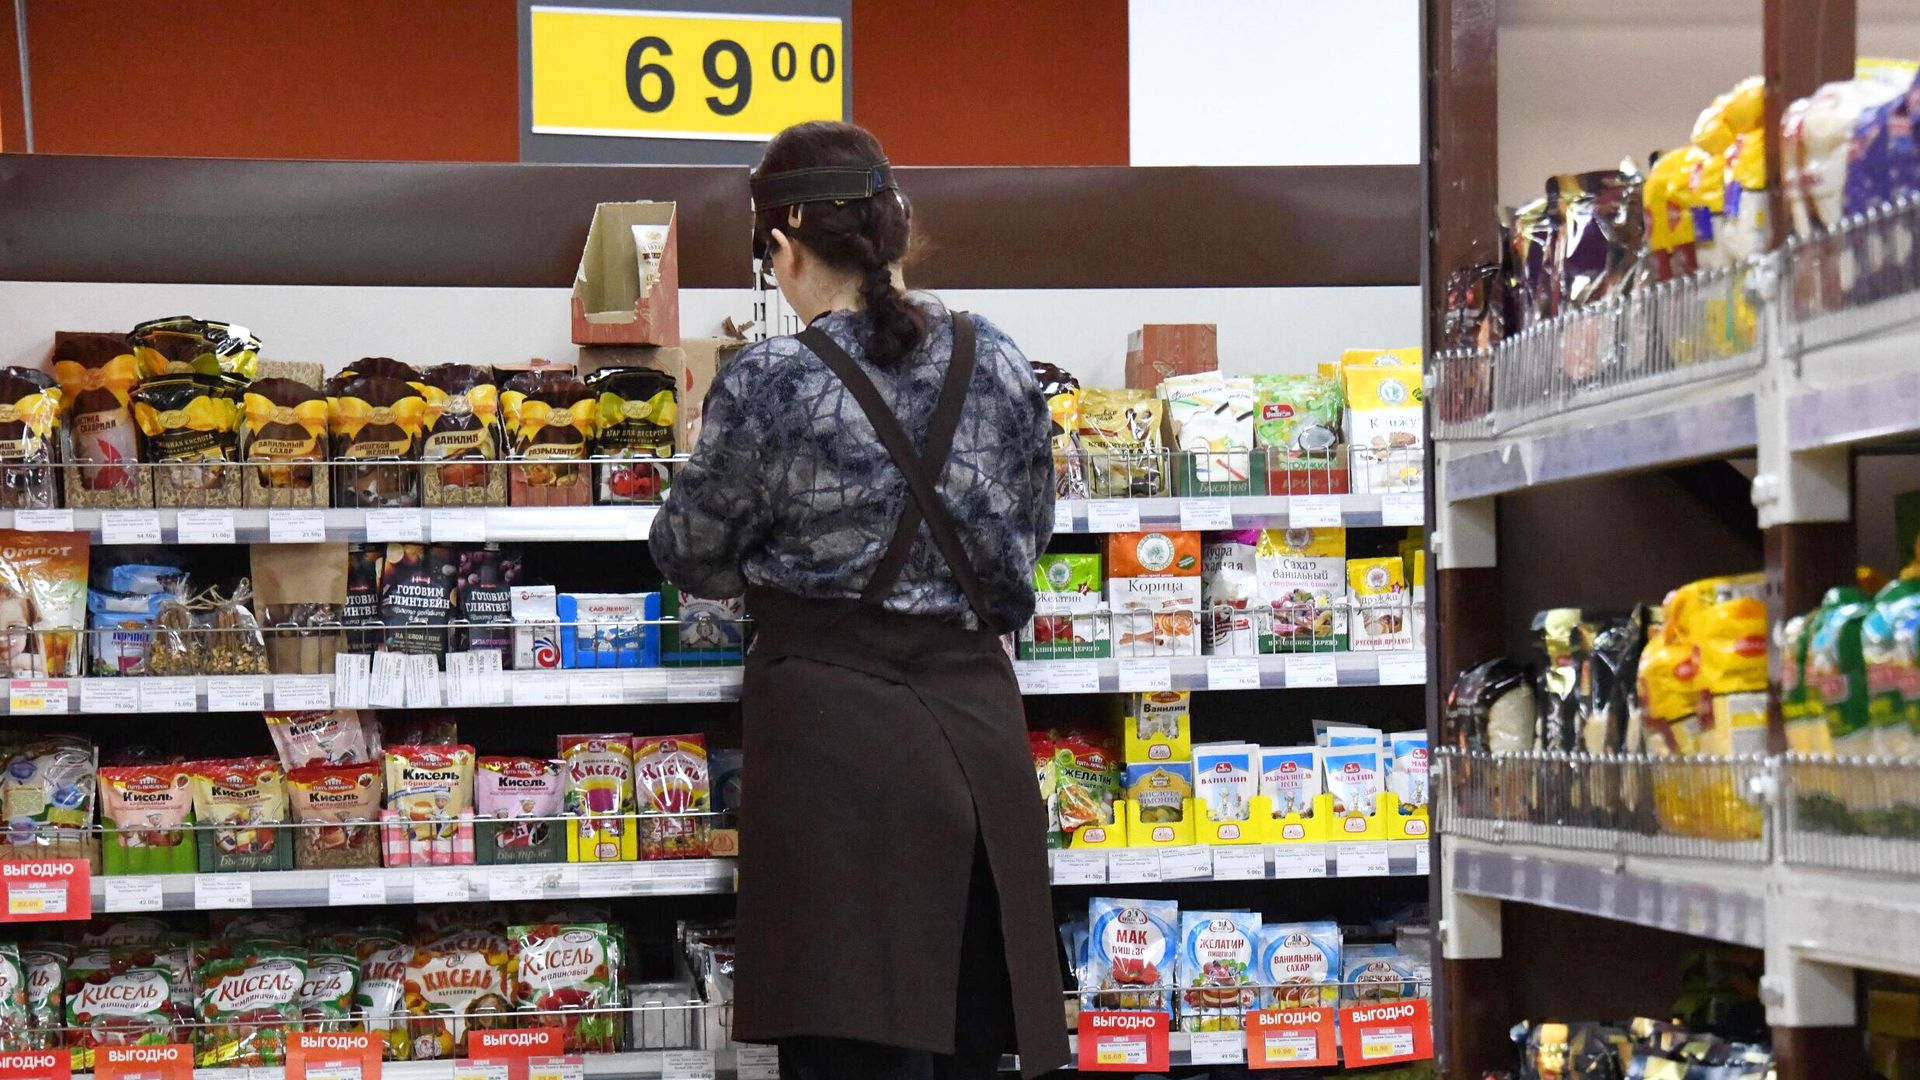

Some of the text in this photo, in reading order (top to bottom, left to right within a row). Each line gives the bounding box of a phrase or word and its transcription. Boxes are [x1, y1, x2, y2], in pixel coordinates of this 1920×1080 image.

[625, 36, 836, 116] 69 00
[258, 442, 304, 450] ВАНИЛЬНЫЙ
[434, 433, 479, 446] ВАНИЛИН
[0, 546, 73, 560] ОМПОТ
[397, 584, 444, 598] ГОТОВИМ
[1128, 580, 1184, 595] Корица
[388, 595, 451, 609] ГЛИНТВЕЙН
[1143, 703, 1186, 713] Ванилин
[403, 769, 460, 780] Кисель
[1201, 776, 1247, 785] ВАНИЛИН
[498, 777, 546, 787] Кисель
[123, 791, 173, 802] Кисель
[212, 786, 260, 798] Кисель
[309, 792, 359, 803] Кисель
[3, 863, 74, 878] ВЫГОДНО
[1116, 929, 1148, 945] МАК
[1199, 938, 1244, 949] ЖЕЛАТИН
[522, 948, 594, 977] КИСЕЛЬ
[1274, 953, 1322, 964] ВАНИЛЬНЫЙ
[1286, 963, 1310, 973] САХАР
[422, 967, 493, 991] КИСЕЛЬ
[219, 974, 293, 1002] КИСЕЛЬ
[81, 984, 159, 1008] КИСЕЛЬ
[1259, 1011, 1321, 1025] ВЫГОДНО
[1352, 1004, 1415, 1023] ВЫГОДНО
[1093, 1015, 1156, 1029] ВЫГОДНО
[301, 1036, 368, 1050] ВЫГОДНО
[483, 1032, 549, 1046] ВЫГОДНО
[108, 1048, 178, 1063] ВЫГОДНО
